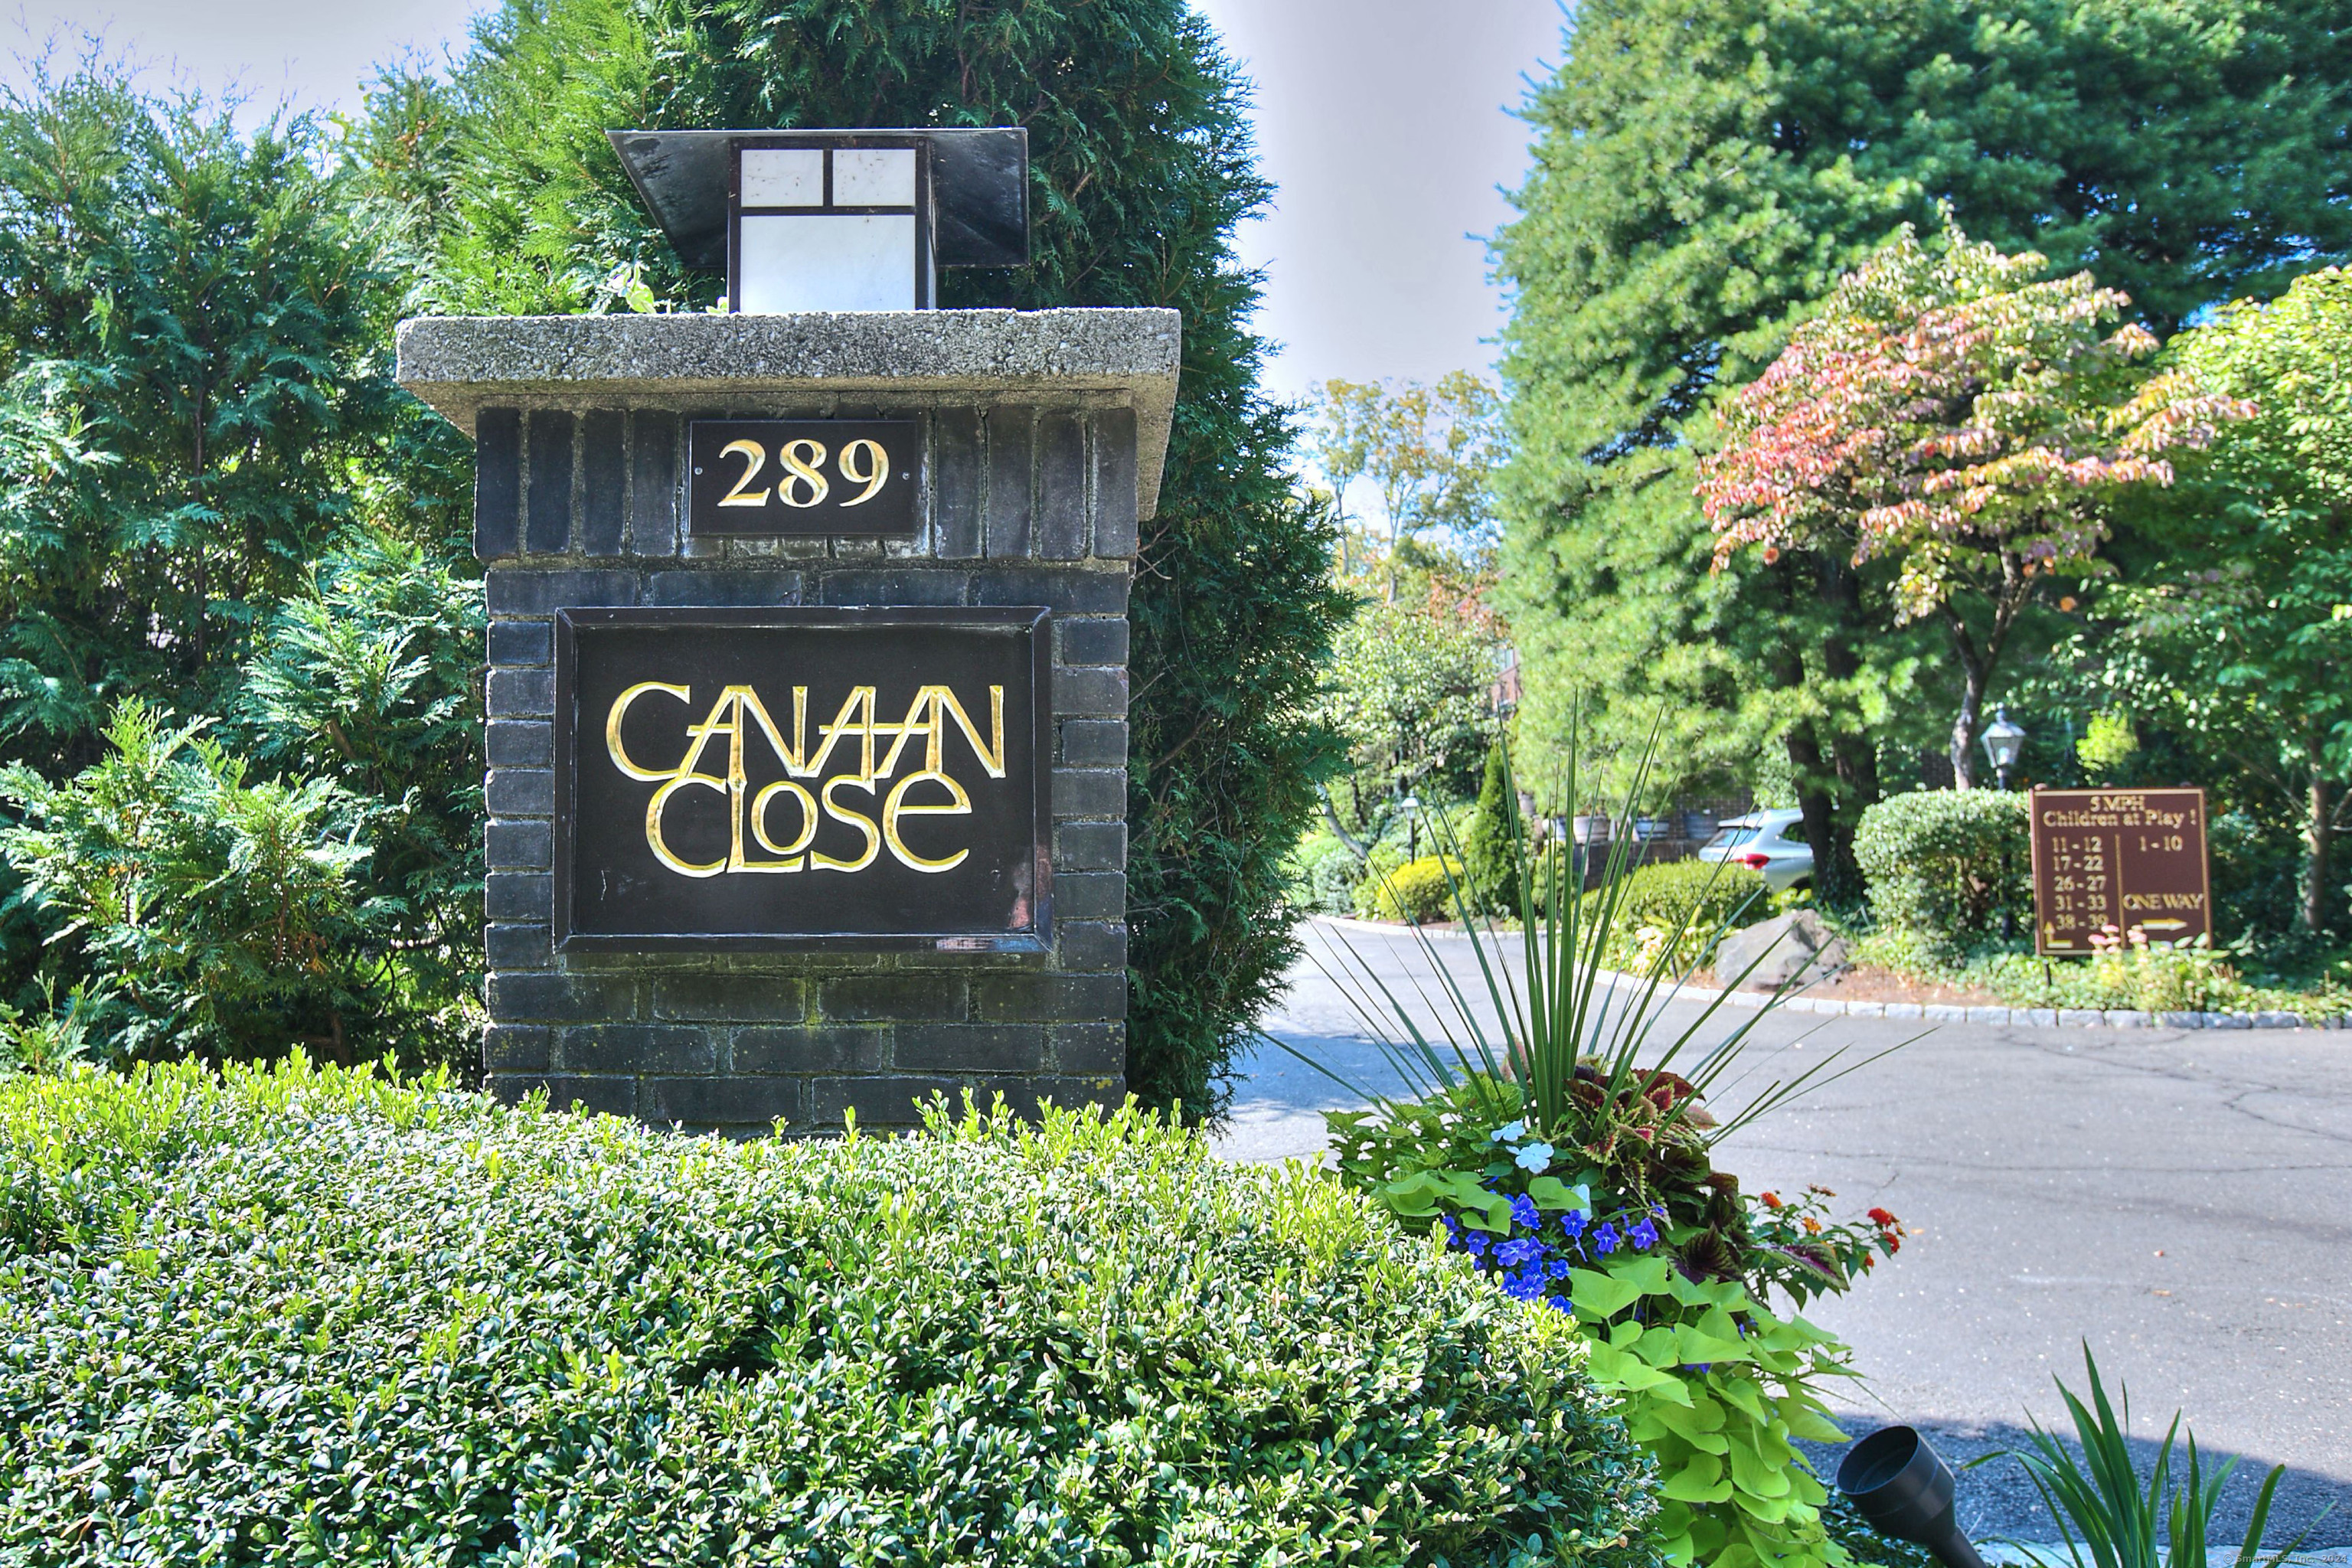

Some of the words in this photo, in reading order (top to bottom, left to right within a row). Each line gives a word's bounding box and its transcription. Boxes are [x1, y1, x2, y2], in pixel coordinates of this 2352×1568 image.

[717, 438, 890, 509] 289
[606, 681, 1007, 782] CANAAN
[2089, 795, 2102, 812] 5
[2102, 795, 2145, 812] MPH
[2043, 810, 2119, 828] Children
[2122, 813, 2141, 827] at
[2144, 808, 2185, 829] Play
[2052, 836, 2069, 854] 11
[2083, 835, 2103, 853] 12
[2164, 835, 2184, 852] 10
[2053, 855, 2072, 872] 17
[2083, 854, 2105, 872] 22
[2053, 875, 2076, 892] 26
[2086, 875, 2107, 892] 27
[2054, 894, 2074, 911] 31
[2087, 894, 2107, 911] 33
[2122, 893, 2163, 911] ONE
[2163, 893, 2204, 910] WAY
